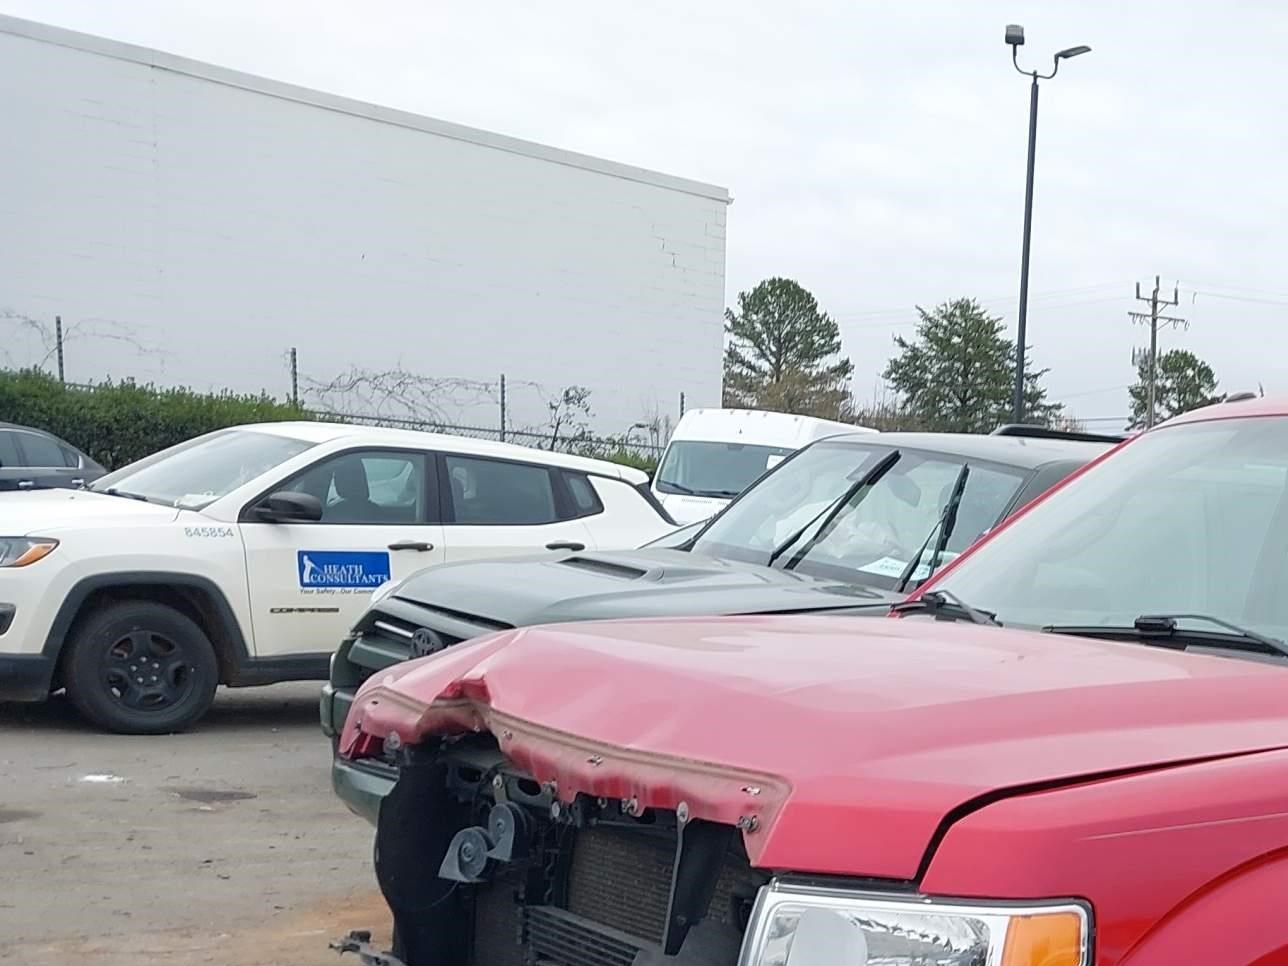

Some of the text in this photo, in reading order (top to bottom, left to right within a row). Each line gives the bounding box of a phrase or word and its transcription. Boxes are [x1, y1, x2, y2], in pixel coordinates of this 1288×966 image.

[184, 527, 234, 538] 845854
[323, 563, 363, 575] HEATH
[310, 573, 388, 584] CONSULTANTS
